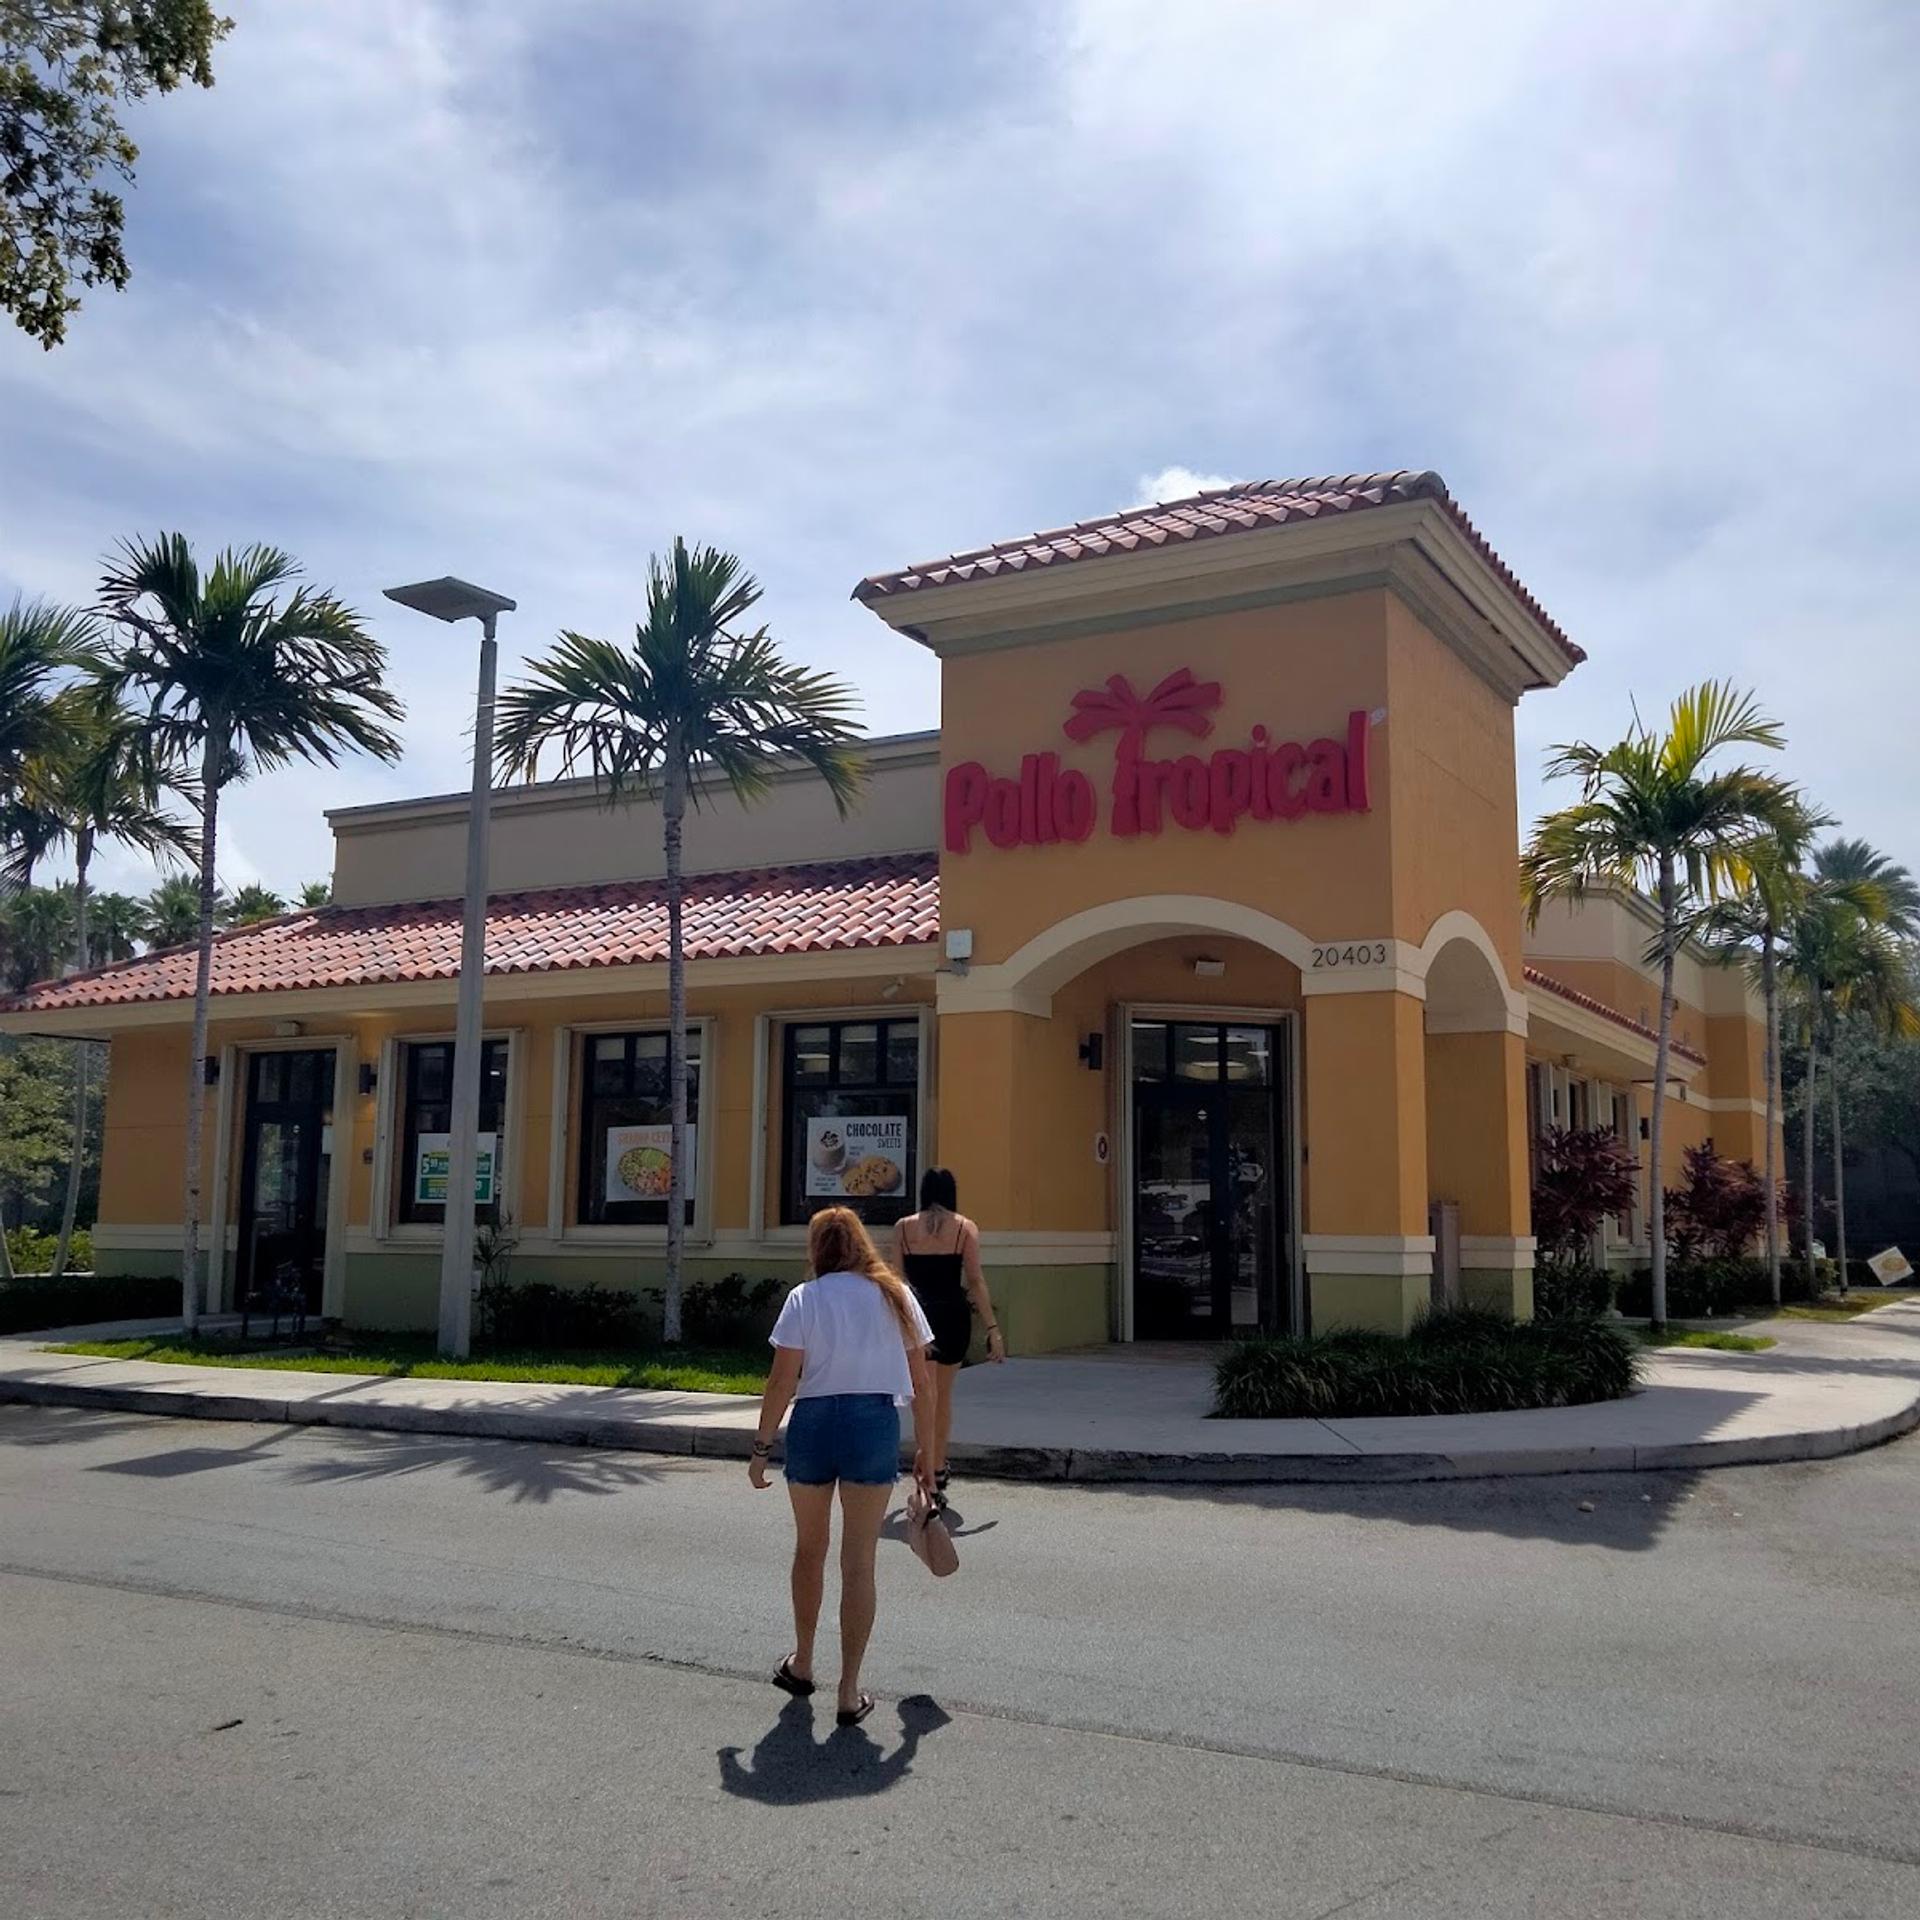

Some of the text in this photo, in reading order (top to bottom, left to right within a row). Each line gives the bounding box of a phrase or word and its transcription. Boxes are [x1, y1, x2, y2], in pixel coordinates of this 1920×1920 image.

[945, 692, 1372, 854] Pollo Tropical
[1311, 943, 1386, 968] 20403
[846, 1123, 902, 1138] CHOCOLATE
